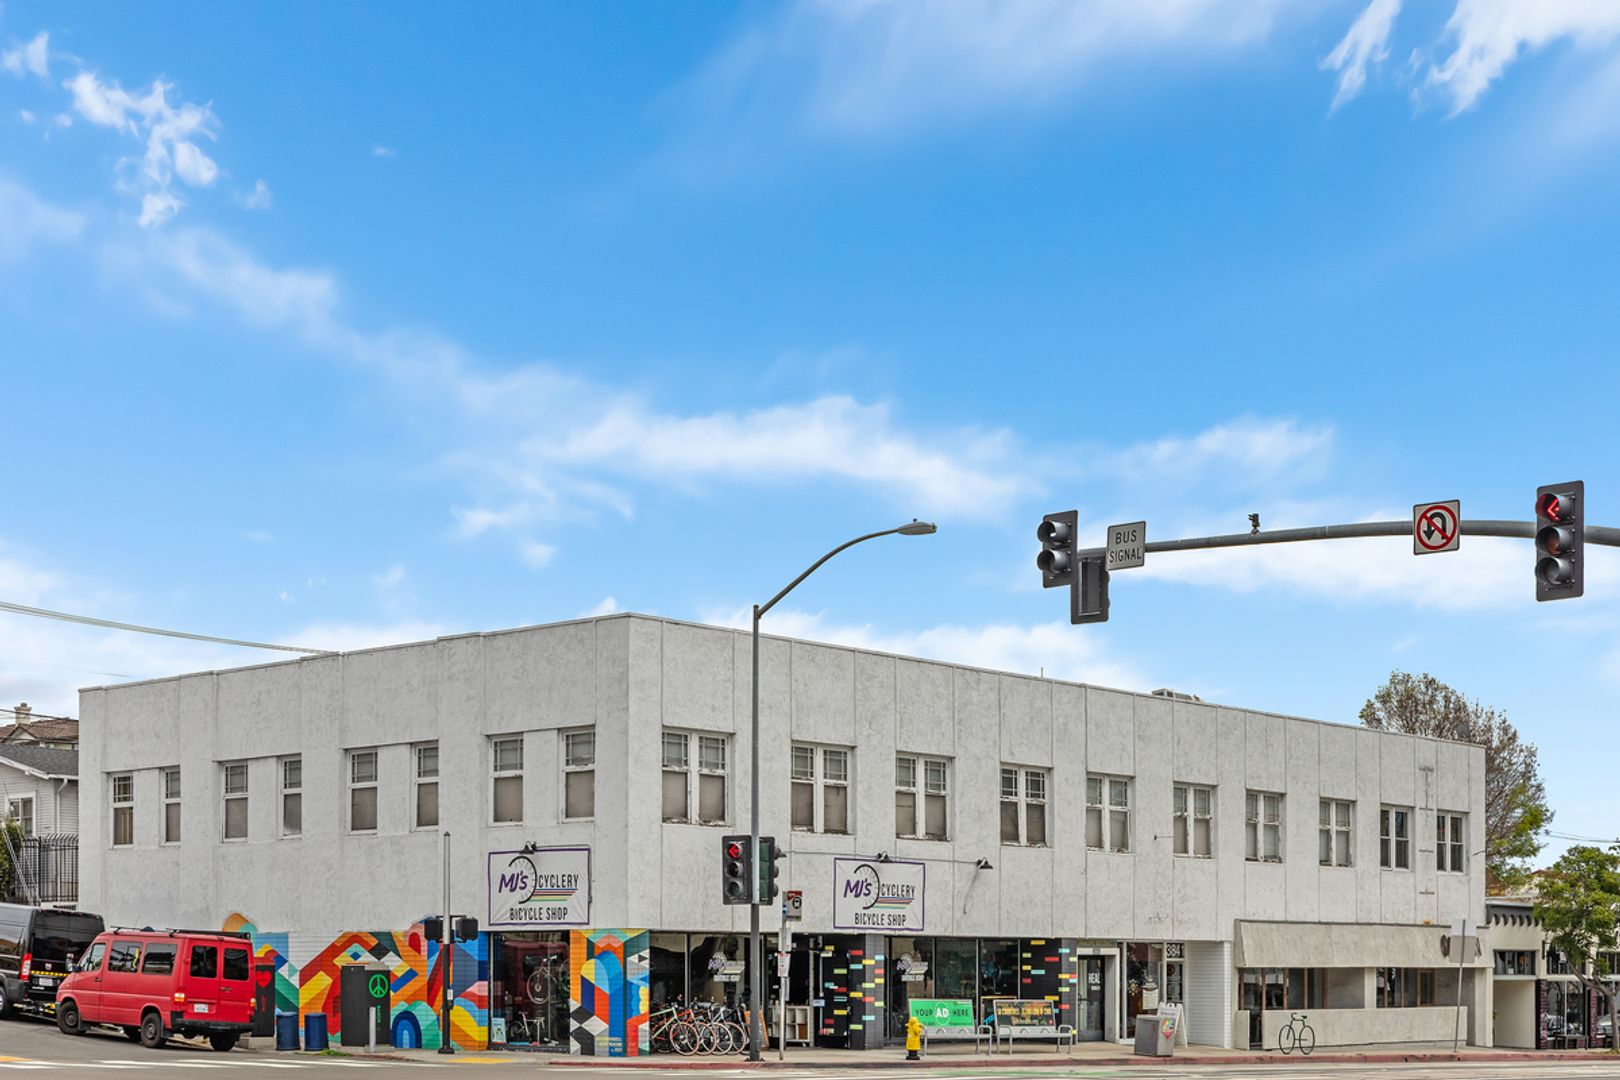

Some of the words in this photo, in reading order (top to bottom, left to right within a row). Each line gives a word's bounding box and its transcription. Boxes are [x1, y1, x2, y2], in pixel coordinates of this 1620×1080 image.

[1115, 529, 1137, 545] BUS
[1109, 547, 1142, 563] SIGNAL
[538, 874, 579, 888] CYCLERY
[880, 883, 916, 897] CYCLERY
[509, 907, 543, 921] BICYCLE
[546, 907, 568, 921] SHOP
[854, 913, 885, 926] BICYCLE
[887, 913, 907, 927] SHOP
[915, 1008, 933, 1017] YOUR
[935, 1007, 949, 1018] AD
[952, 1008, 969, 1017] HERE
